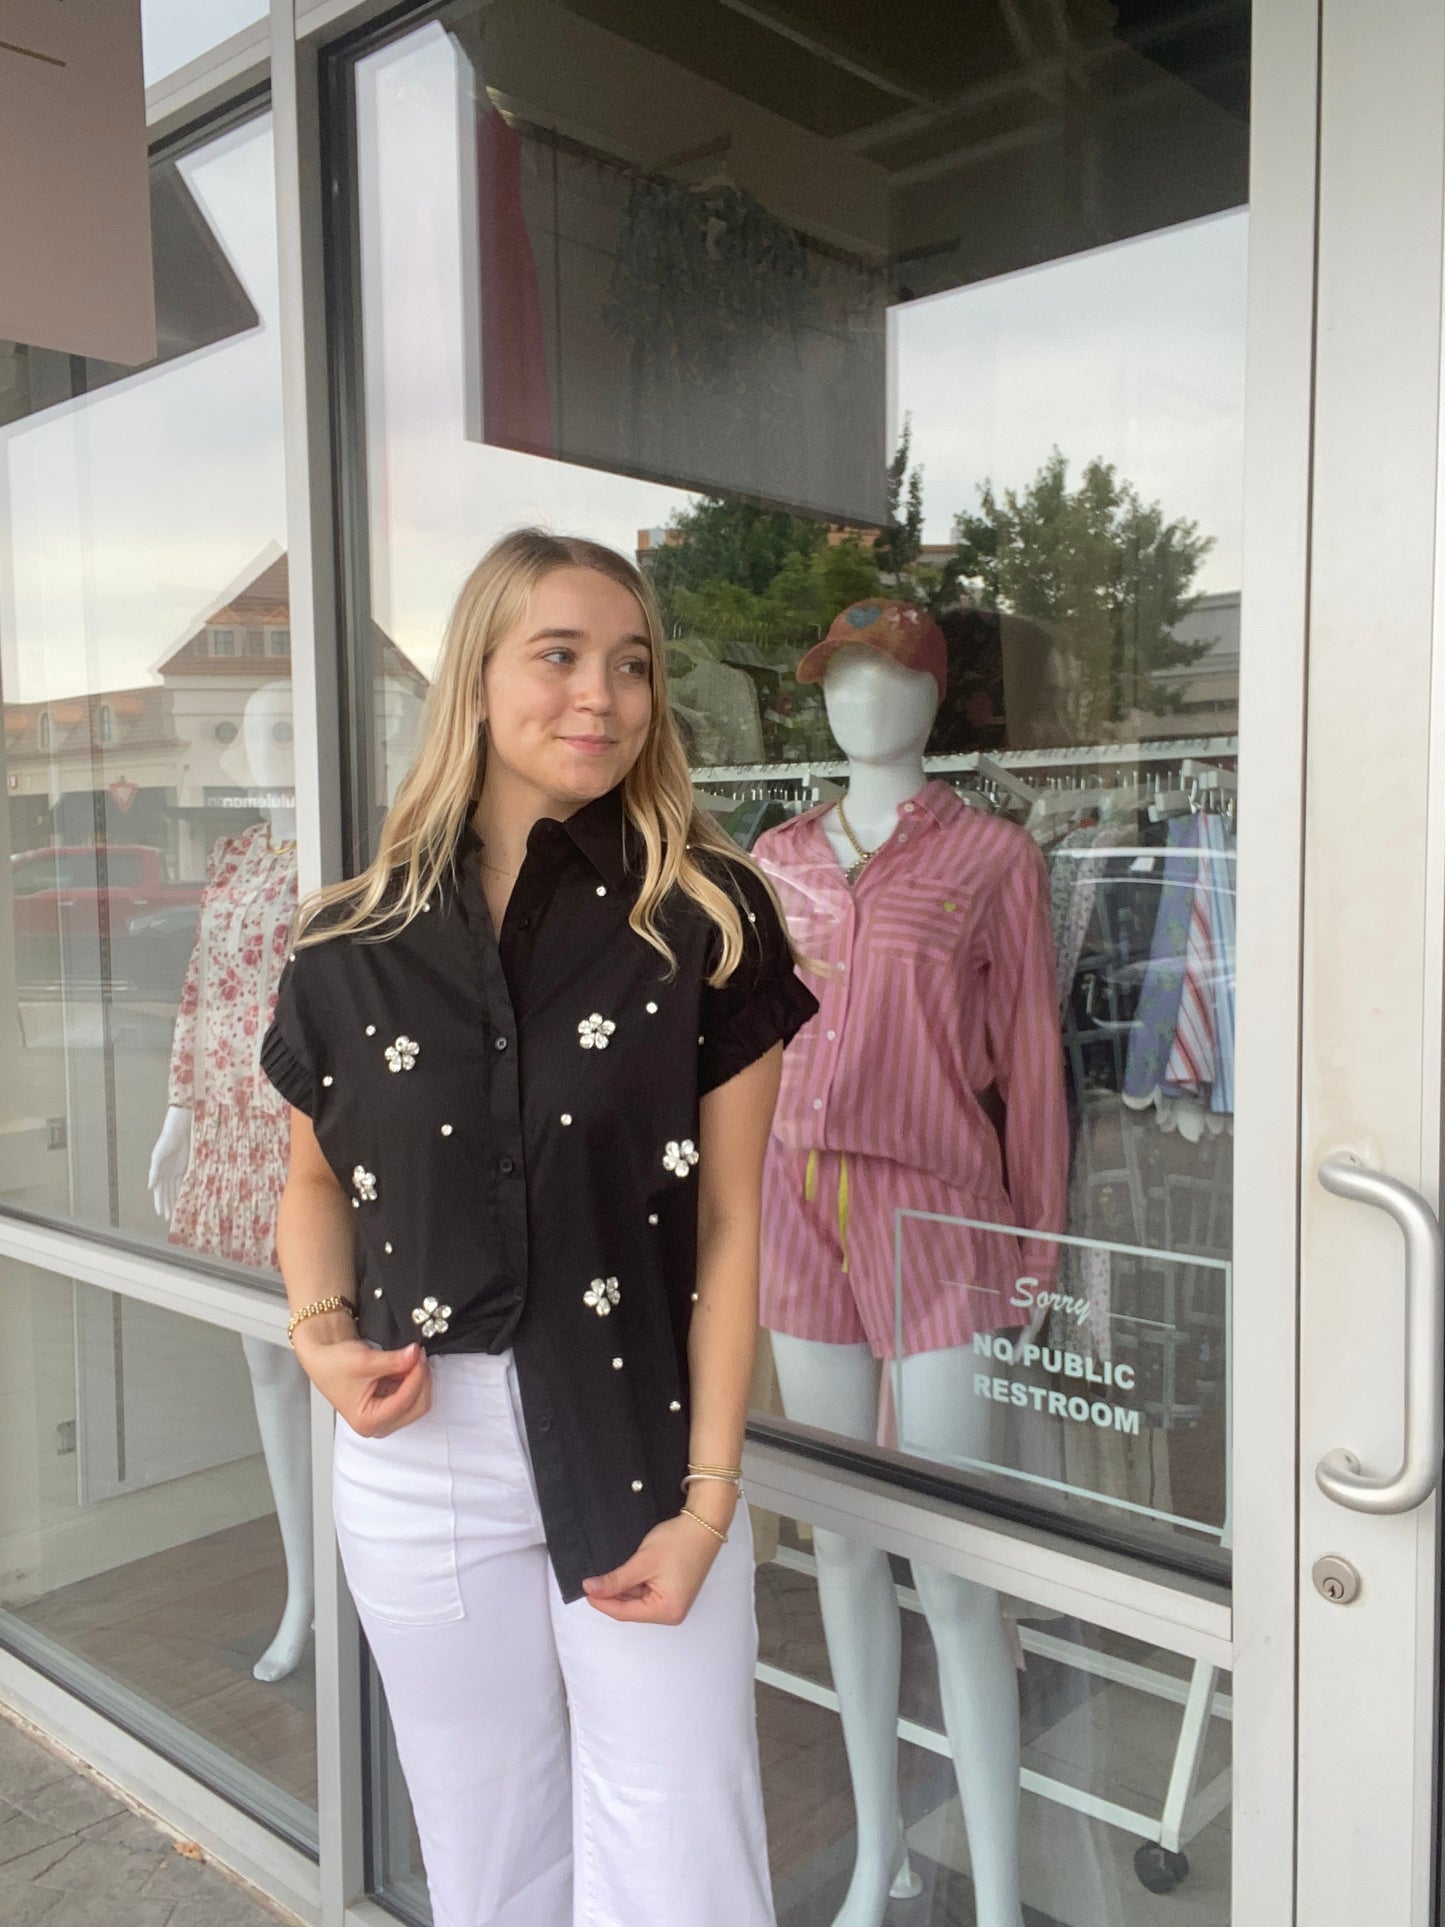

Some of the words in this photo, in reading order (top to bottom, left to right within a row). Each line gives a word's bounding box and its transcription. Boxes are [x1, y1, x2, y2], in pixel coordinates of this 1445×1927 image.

[1011, 1277, 1091, 1325] Sorry
[973, 1332, 1014, 1362] NO
[1024, 1343, 1135, 1389] PUBLIC
[973, 1373, 1139, 1435] RESTROOM
